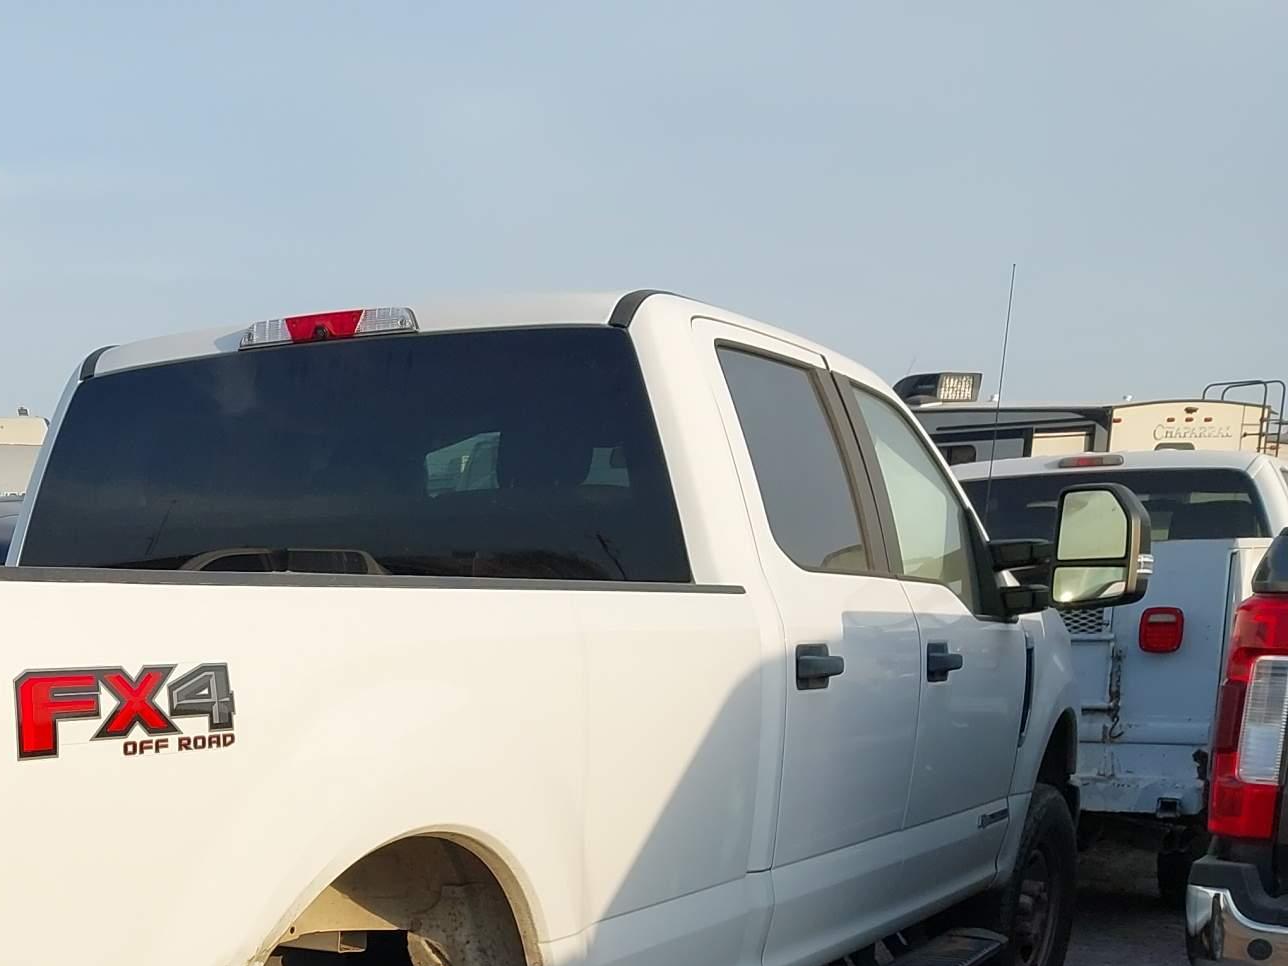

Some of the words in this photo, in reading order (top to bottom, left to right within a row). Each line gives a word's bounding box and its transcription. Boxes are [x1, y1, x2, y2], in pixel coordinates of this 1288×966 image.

[1153, 424, 1232, 440] CHAPARRAL
[13, 663, 235, 761] FX4
[123, 738, 169, 756] OFF
[178, 733, 235, 751] ROAD
